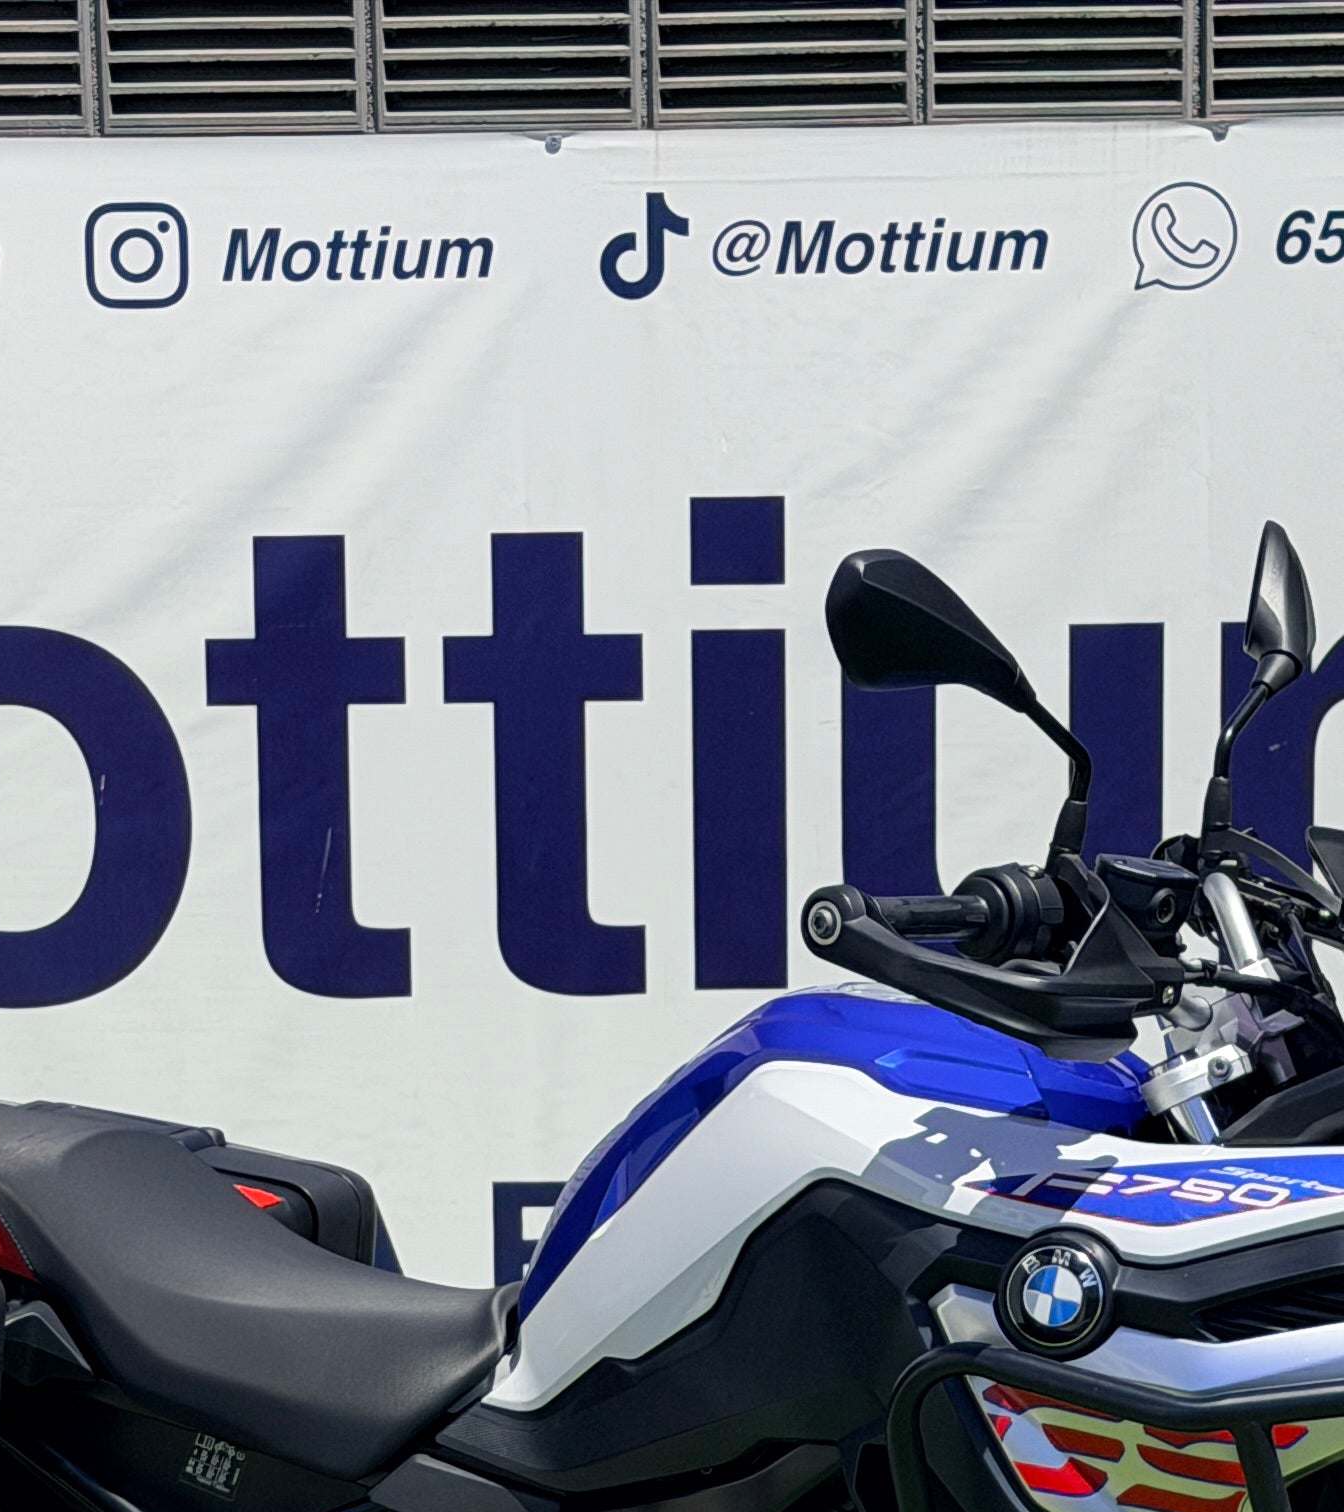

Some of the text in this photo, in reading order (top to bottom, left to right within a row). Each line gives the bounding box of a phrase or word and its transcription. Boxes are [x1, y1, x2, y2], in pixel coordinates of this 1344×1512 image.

[222, 225, 494, 282] Mottium
[712, 217, 1049, 277] @Mottium
[1021, 1248, 1098, 1289] BMW
